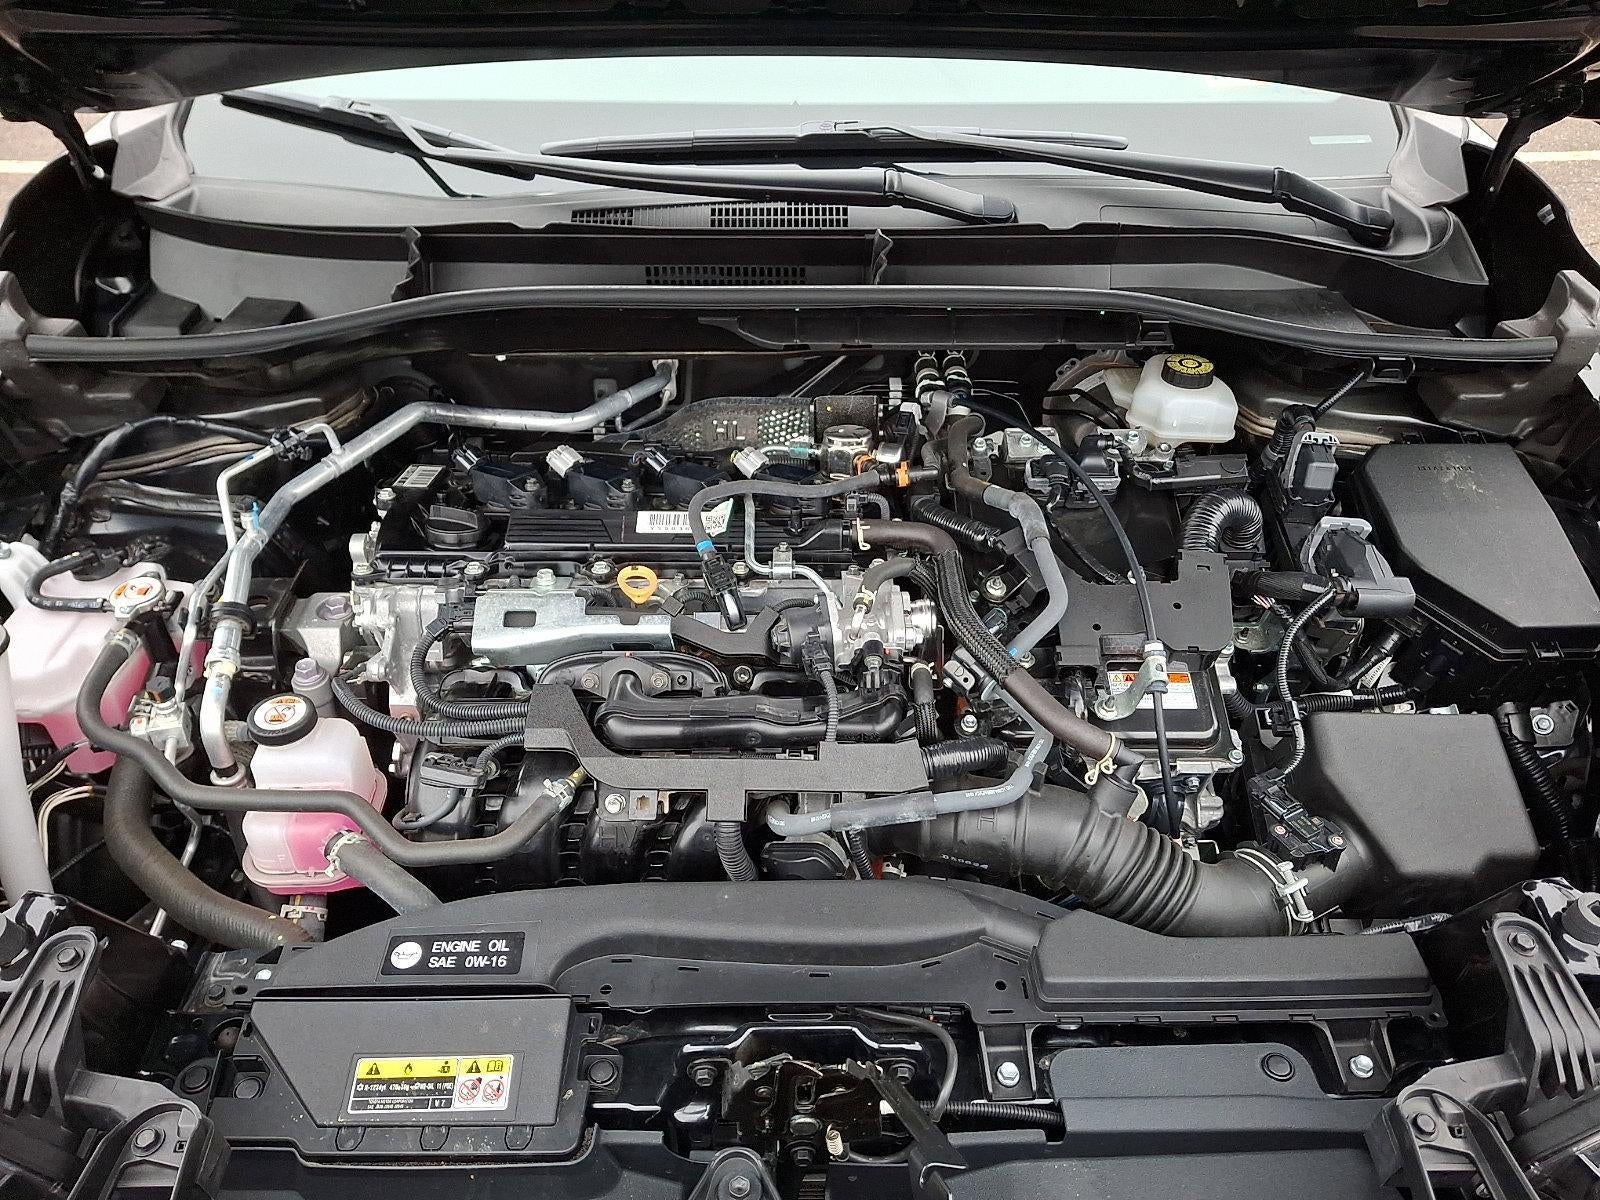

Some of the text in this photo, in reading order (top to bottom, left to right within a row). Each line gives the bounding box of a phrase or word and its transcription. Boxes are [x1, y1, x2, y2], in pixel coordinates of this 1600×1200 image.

[431, 939, 510, 953] ENGINE OIL
[428, 955, 507, 968] SAE 0W-16
